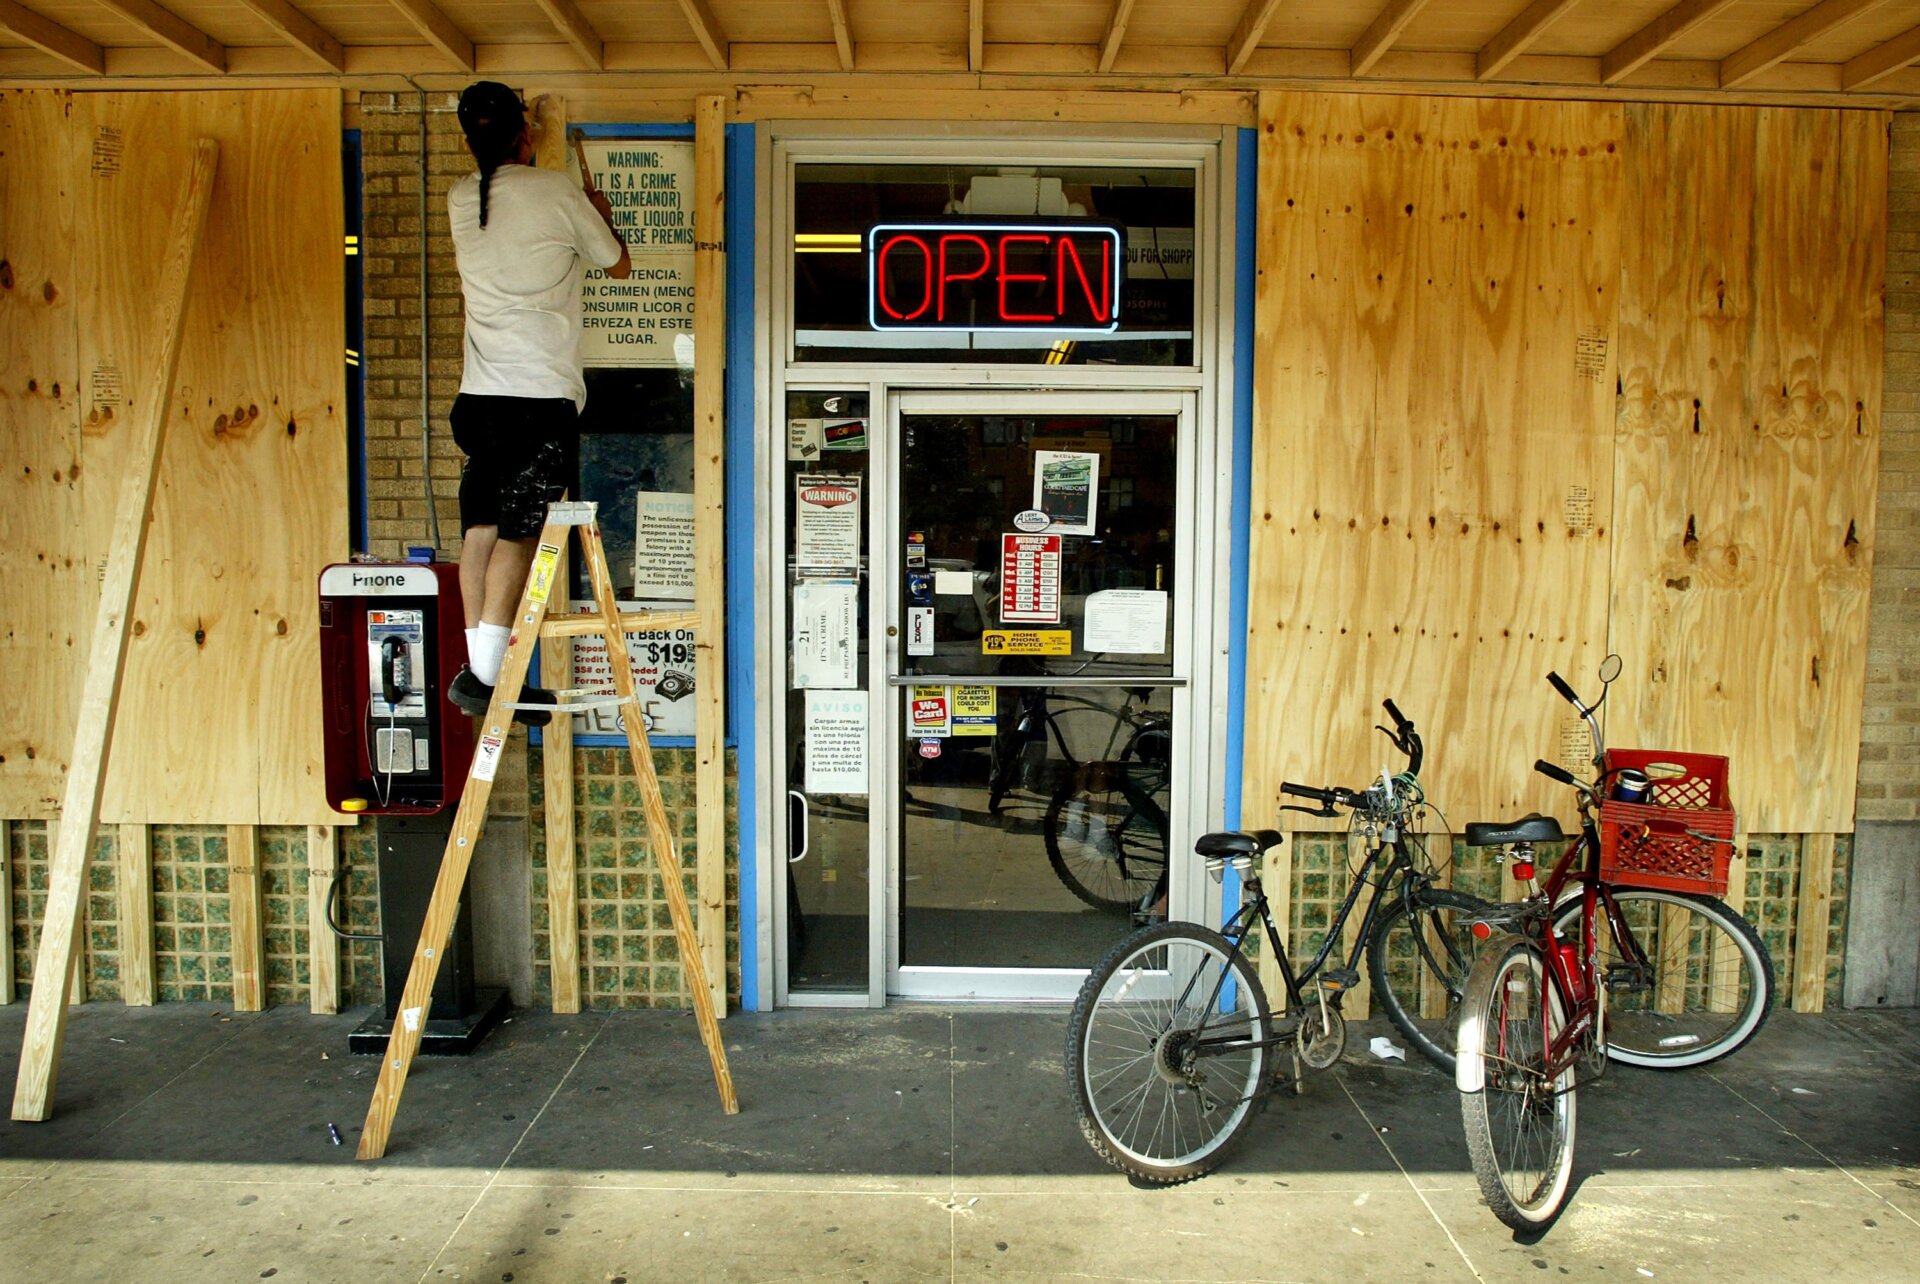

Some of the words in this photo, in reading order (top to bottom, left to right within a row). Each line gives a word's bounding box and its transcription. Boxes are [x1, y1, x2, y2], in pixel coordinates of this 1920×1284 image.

[607, 152, 664, 168] WARNING:
[593, 172, 604, 189] IT
[610, 172, 621, 189] IS
[627, 172, 635, 189] A
[641, 172, 677, 189] CRIME
[643, 210, 684, 228] LIQUOR
[651, 228, 695, 244] PREMIS
[1126, 247, 1138, 263] OU
[1161, 248, 1193, 264] SHOPP
[585, 269, 682, 280] ADVTENCIA:
[878, 234, 1109, 322] OPEN
[599, 286, 650, 297] CRIMEN
[643, 302, 682, 313] LICOR
[582, 317, 633, 328] ERVEZA
[638, 318, 655, 329] EN
[660, 318, 693, 329] ESTE
[607, 333, 658, 345] LUGAR.
[804, 490, 853, 502] WARNING
[638, 630, 671, 640] Back
[675, 629, 694, 640] On
[799, 630, 809, 643] 21
[574, 645, 607, 653] Deposi
[648, 642, 687, 665] $19
[632, 666, 658, 674] eeded
[574, 677, 604, 685] Forms
[639, 678, 656, 686] Out
[812, 703, 862, 713] AVISO
[918, 701, 939, 710] We
[914, 709, 944, 719] Card
